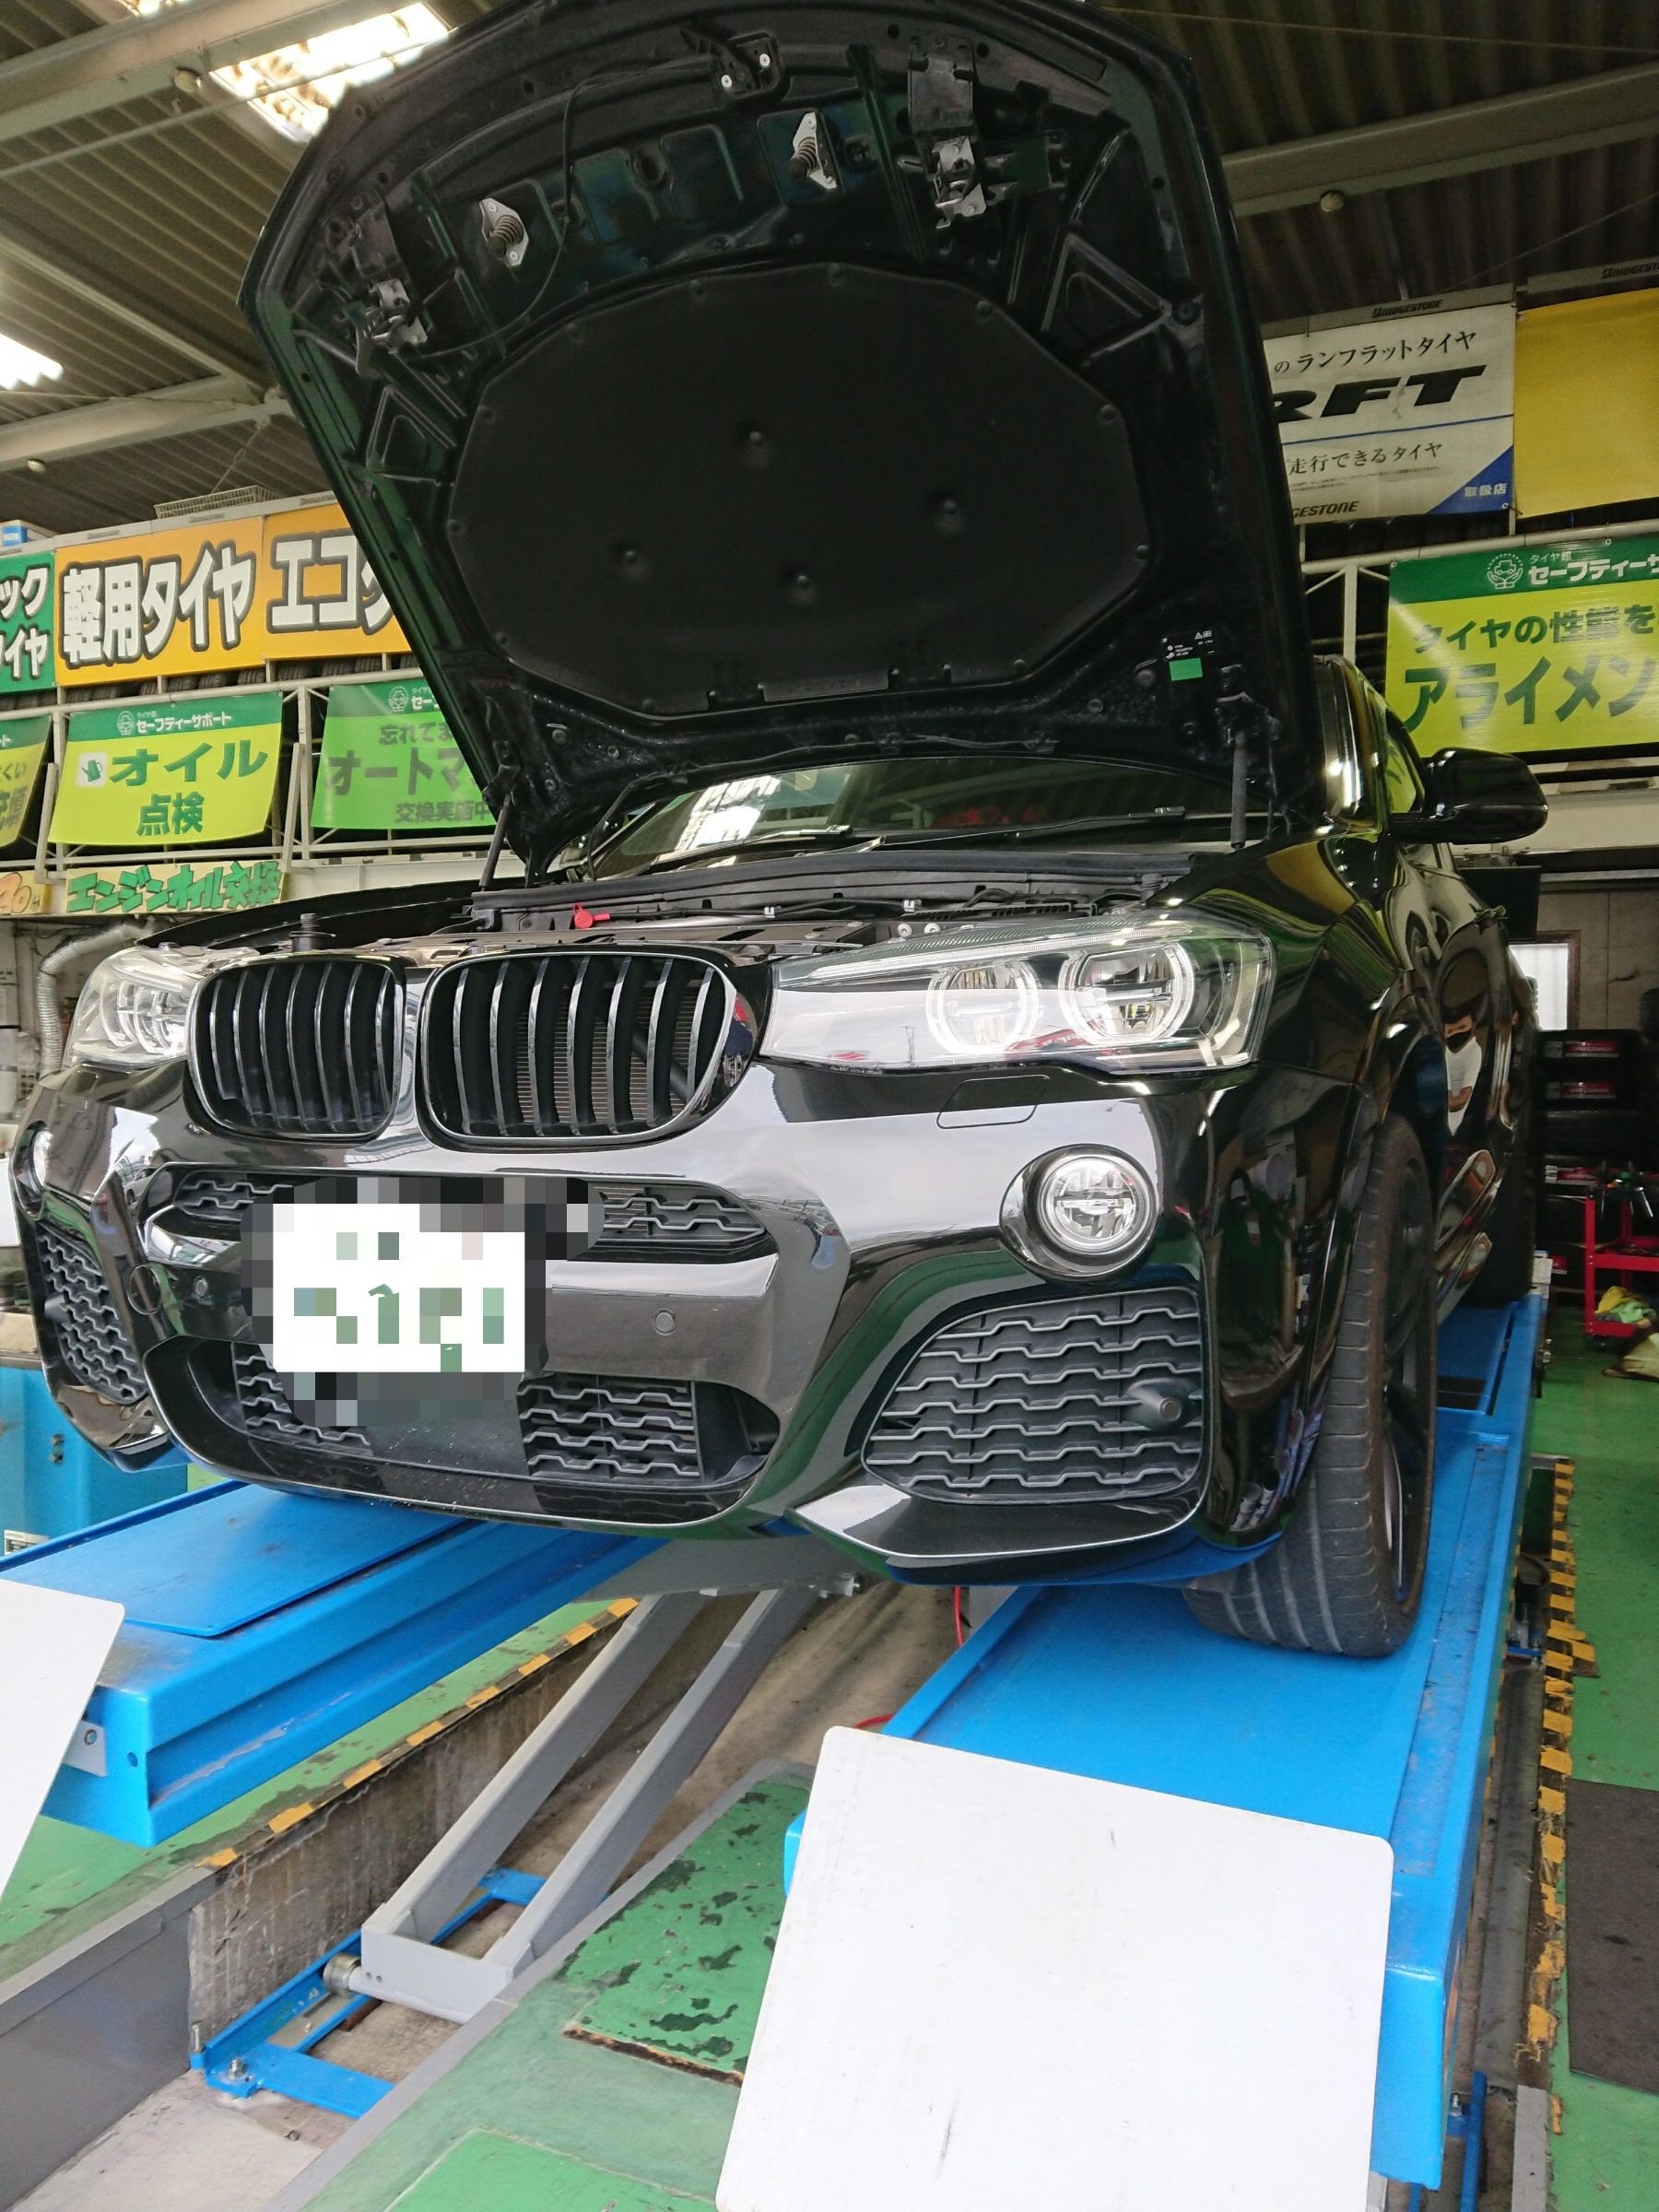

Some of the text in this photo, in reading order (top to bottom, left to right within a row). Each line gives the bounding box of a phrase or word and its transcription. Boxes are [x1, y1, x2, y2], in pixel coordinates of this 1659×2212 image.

[1371, 299, 1443, 319] BRIDGESTONE
[1464, 482, 1508, 498] 取扱店
[1530, 550, 1572, 565] タイヤ館
[62, 545, 254, 665] 軽用タイヤ
[1414, 605, 1659, 654] タイヤの性能を
[0, 628, 49, 679] イヤ
[411, 695, 440, 710] セー
[1403, 654, 1657, 734] アライメン
[136, 711, 232, 734] セーフティーサポート
[109, 739, 269, 787] オイル
[326, 747, 477, 796] オートマ
[136, 791, 205, 837] 点検
